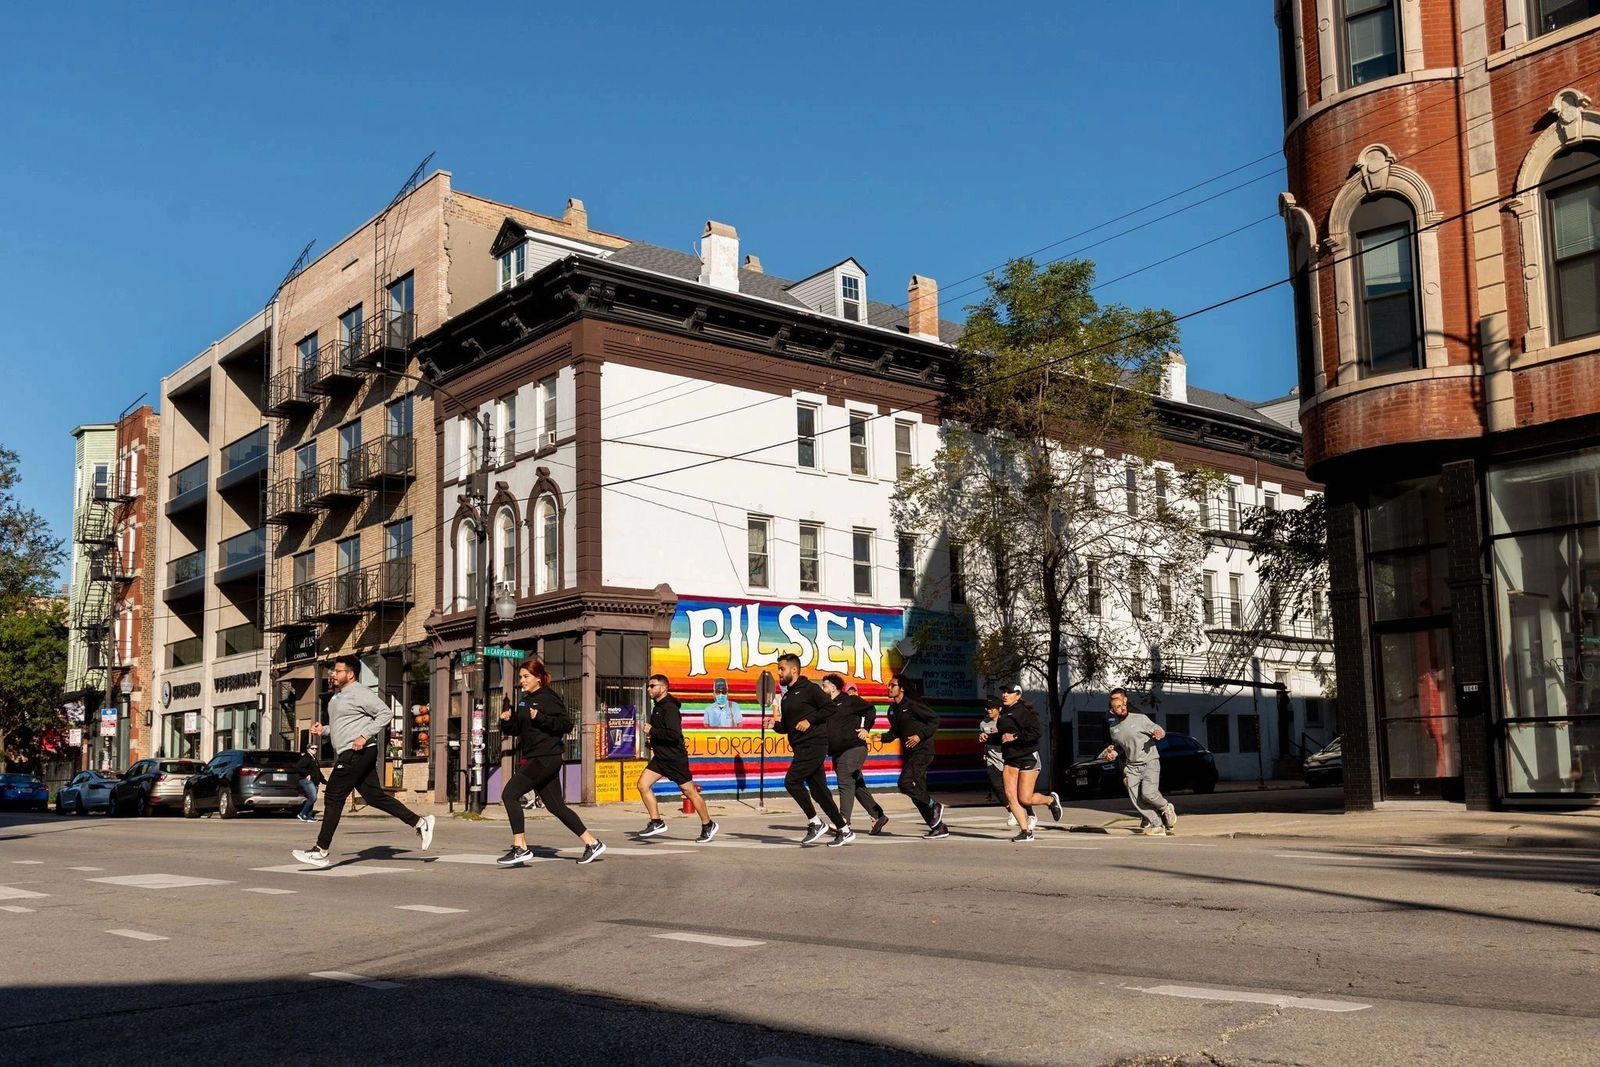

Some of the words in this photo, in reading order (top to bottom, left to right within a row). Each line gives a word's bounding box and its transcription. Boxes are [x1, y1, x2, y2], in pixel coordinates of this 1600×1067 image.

[490, 648, 518, 657] CARPENTER
[686, 602, 884, 684] PILSEN
[214, 670, 262, 693] VETERINARY
